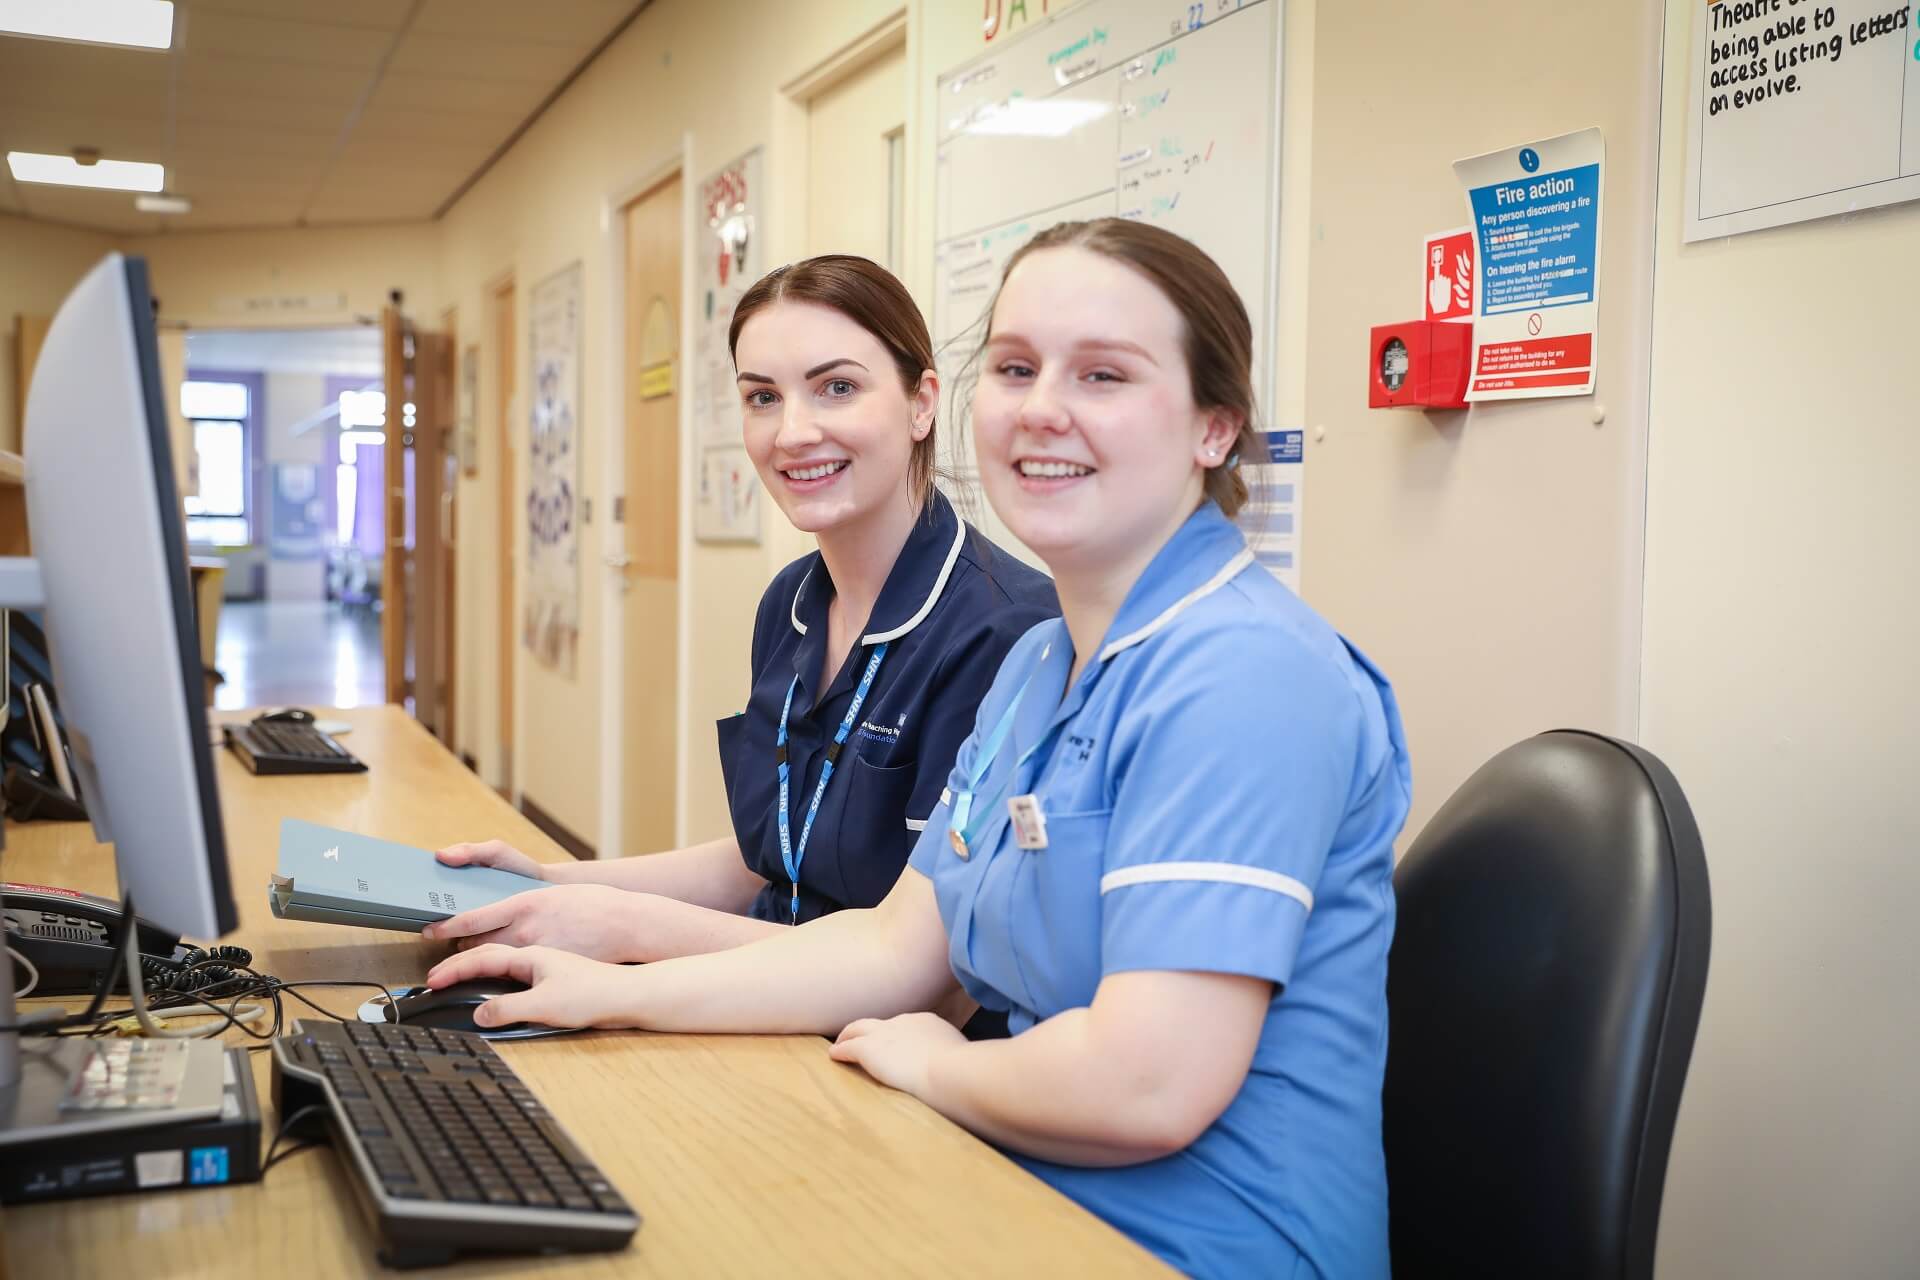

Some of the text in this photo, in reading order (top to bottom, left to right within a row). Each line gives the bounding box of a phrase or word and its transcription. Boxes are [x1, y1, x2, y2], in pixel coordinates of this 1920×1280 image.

[1710, 58, 1767, 88] access
[1774, 35, 1843, 72] listing
[1850, 6, 1910, 46] letters
[1711, 7, 1835, 64] being able to
[1734, 74, 1801, 109] evolve.
[1496, 178, 1574, 205] Fire action
[1482, 215, 1497, 226] Any
[1499, 211, 1525, 224] person
[1527, 201, 1569, 218] discovering
[1578, 196, 1590, 207] fire
[1487, 255, 1576, 276] On hearing the fire alarm
[863, 654, 880, 686] NHS
[845, 694, 863, 725] NHS
[811, 781, 826, 812] NHS
[779, 823, 790, 854] NHS
